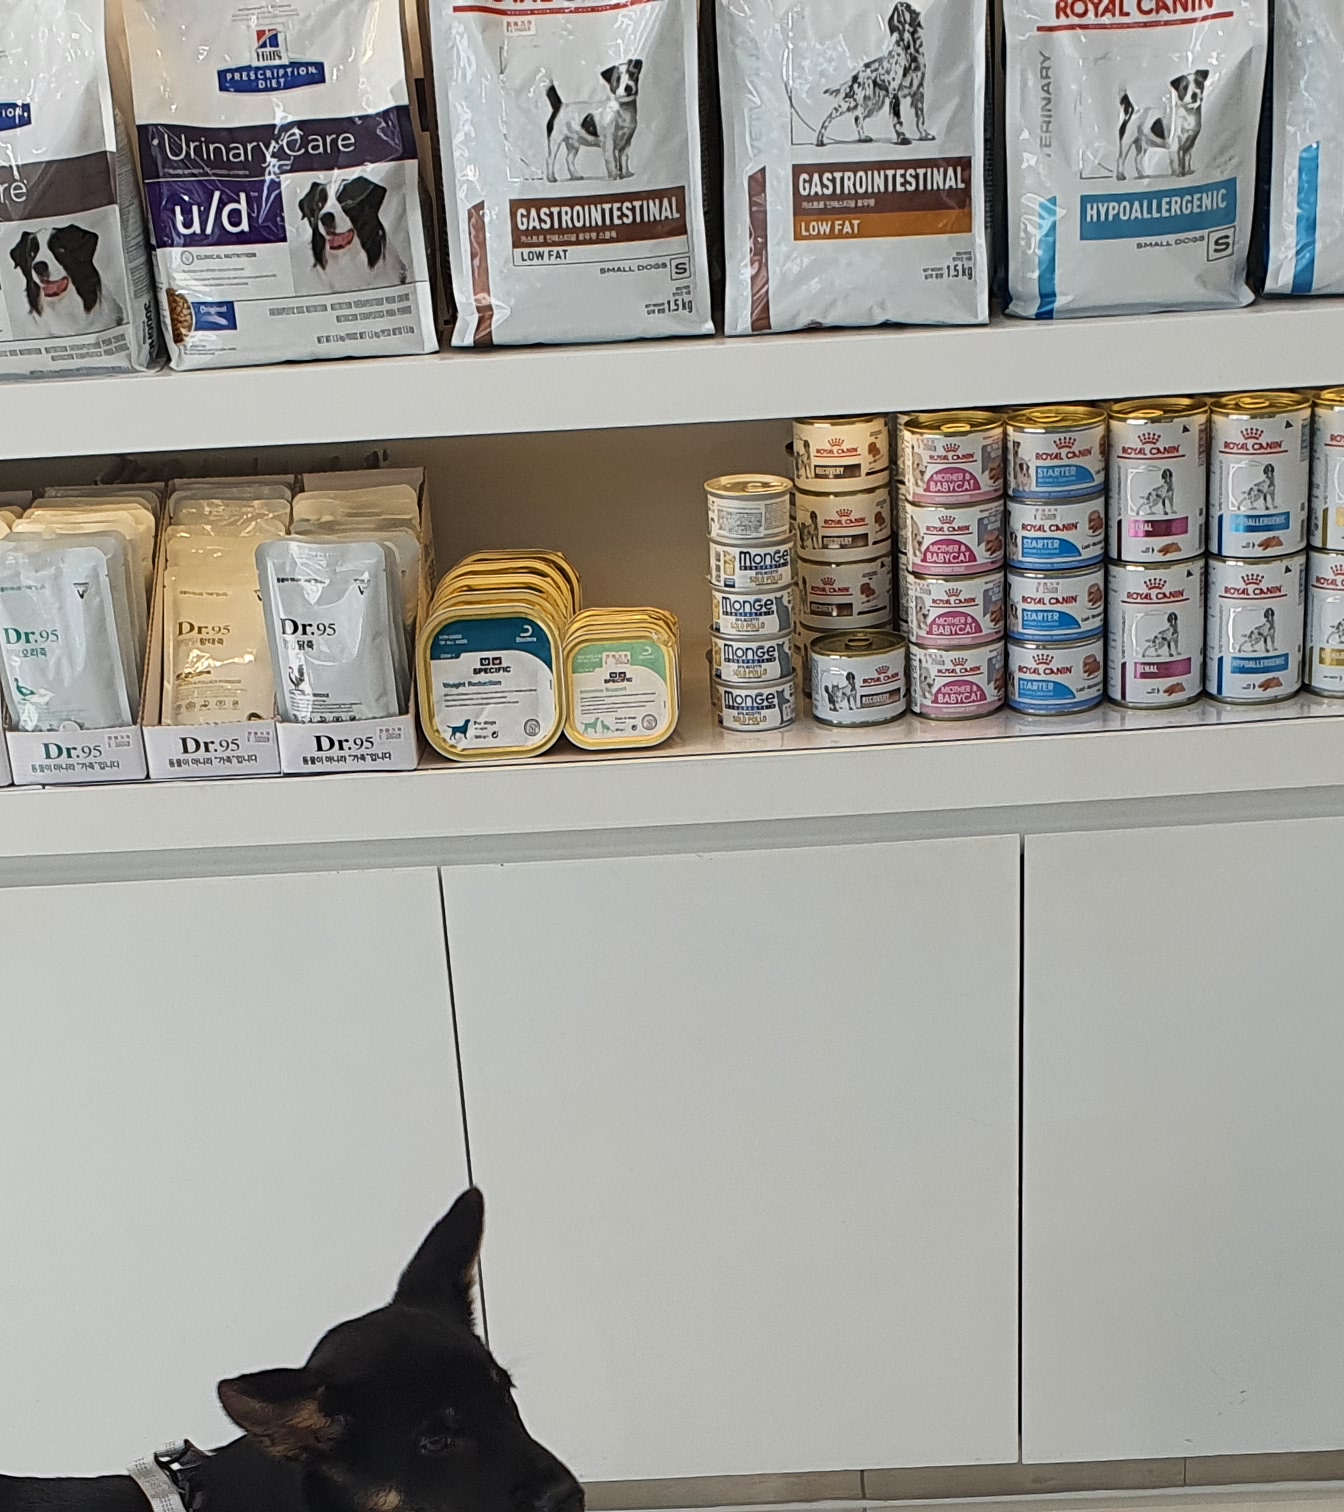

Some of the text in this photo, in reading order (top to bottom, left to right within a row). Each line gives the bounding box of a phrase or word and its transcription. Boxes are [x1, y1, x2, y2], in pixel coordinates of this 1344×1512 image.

[1055, 0, 1214, 20] ROYAL CANIN
[257, 51, 282, 62] Hill's
[226, 66, 318, 81] PRESCRIPTION
[258, 79, 285, 88] DIET
[165, 132, 355, 167] Urinary Care
[799, 166, 965, 196] GASTROINTESTINAL
[1086, 188, 1227, 223] HYPOALLERGENIC
[175, 191, 249, 235] u/d
[517, 196, 680, 231] GASTROINTESTINAL
[801, 220, 860, 236] LOW FAT
[1136, 235, 1230, 253] SMALL DOGS S
[521, 249, 569, 262] LOW FAT
[600, 262, 688, 275] SMALL DOGS S
[946, 264, 973, 280] 1.5 kg
[667, 299, 693, 313] 1.5 kg
[1122, 445, 1180, 456] ROYAL CANIN
[1224, 441, 1283, 451] ROYAL CANIN
[1035, 449, 1092, 461] ROYAL CANIN
[1038, 467, 1076, 477] STARTER
[930, 481, 974, 491] BABYCAT
[1021, 522, 1078, 532] ROYAL CANIN
[1023, 539, 1060, 548] STARTER
[926, 552, 970, 562] BABYCAT
[1316, 577, 1338, 587] ROYAL
[1127, 590, 1184, 601] ROYAL CANIN
[1225, 586, 1282, 596] ROYAL CANIN
[1022, 595, 1078, 605] ROYAL CANIN
[1024, 612, 1059, 621] STARTER
[177, 620, 231, 637] Dr.95
[280, 618, 336, 636] Dr.95
[933, 624, 975, 634] BABYCAT
[3, 627, 59, 645] Dr.95
[472, 666, 511, 675] SPECIFIC
[1018, 665, 1073, 675] ROYAL CANIN
[442, 680, 502, 689] Weight Reduction
[1020, 682, 1054, 690] STARTER
[938, 693, 980, 703] BABYCAT
[180, 736, 240, 754] Dr.95
[313, 735, 375, 753] Dr.95
[42, 742, 102, 760] Dr.95
